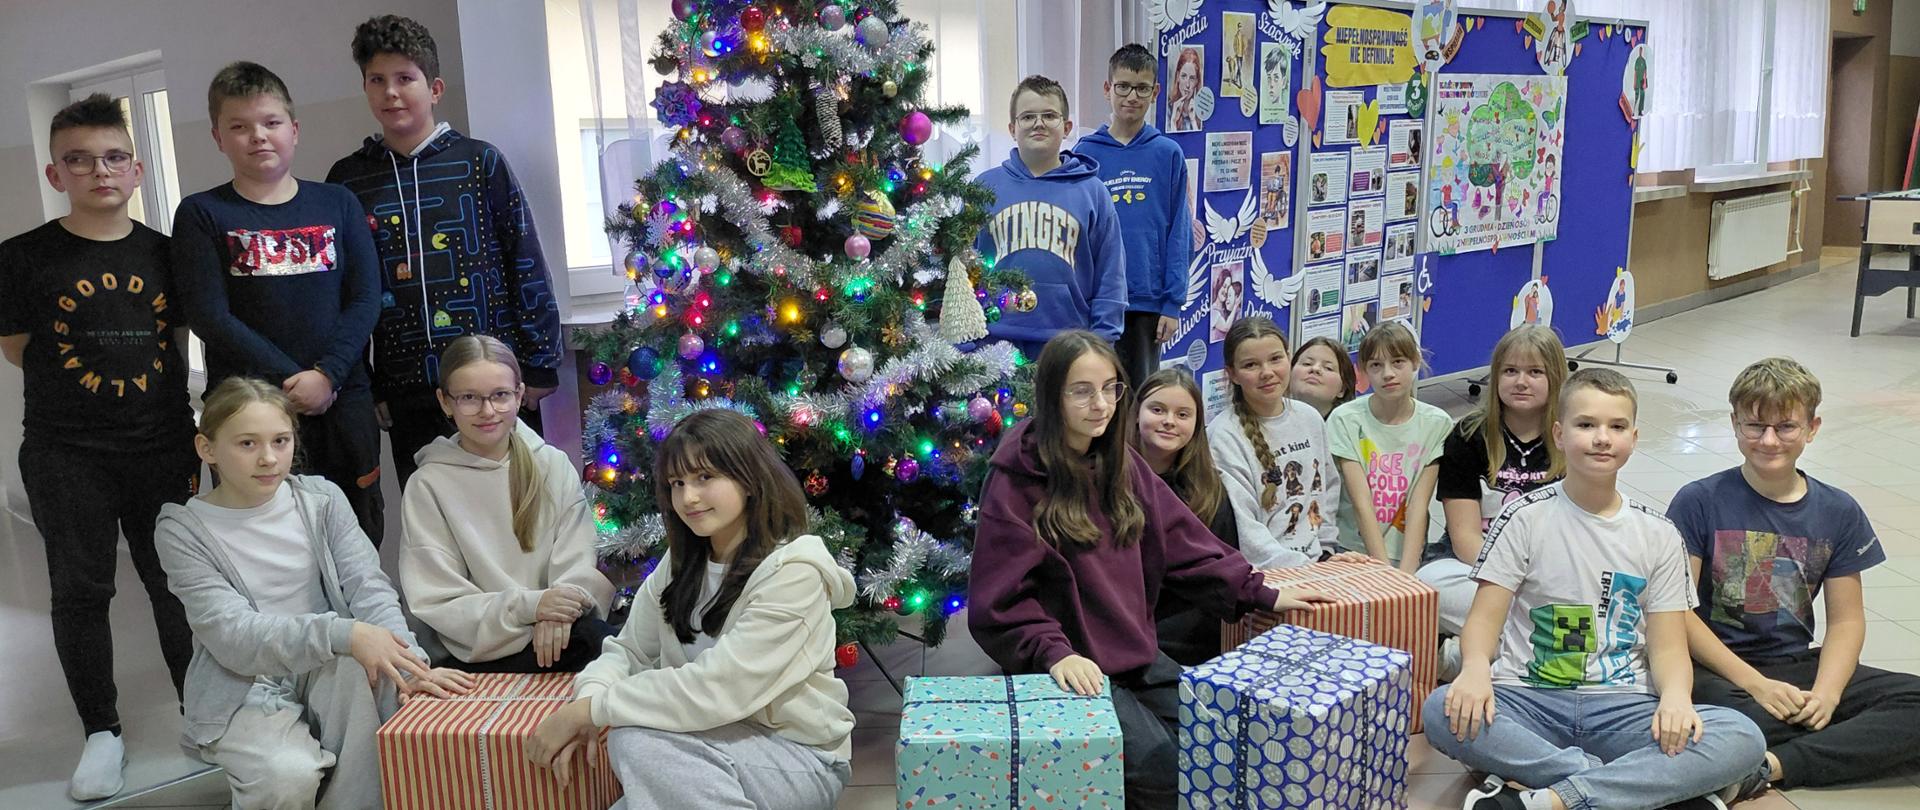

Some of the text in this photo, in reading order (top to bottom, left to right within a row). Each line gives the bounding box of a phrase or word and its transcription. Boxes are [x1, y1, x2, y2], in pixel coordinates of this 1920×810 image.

[1161, 14, 1209, 57] Empatia
[1258, 12, 1302, 60] Szacunek
[1336, 27, 1408, 47] NIEPEŁNOSPRAWNOŚĆ
[1350, 47, 1395, 64] NIE DEFINIUJE
[1411, 79, 1421, 99] 3
[989, 201, 1080, 269] WINGER
[58, 272, 144, 313] GOOD
[152, 292, 168, 373] WAYS
[54, 320, 148, 397] ALWAYS
[1287, 438, 1311, 453] kind
[1366, 474, 1408, 491] COLD
[1479, 518, 1508, 560] SURVIVAL
[1503, 498, 1530, 518] MODE
[1598, 571, 1612, 619] CREEPER
